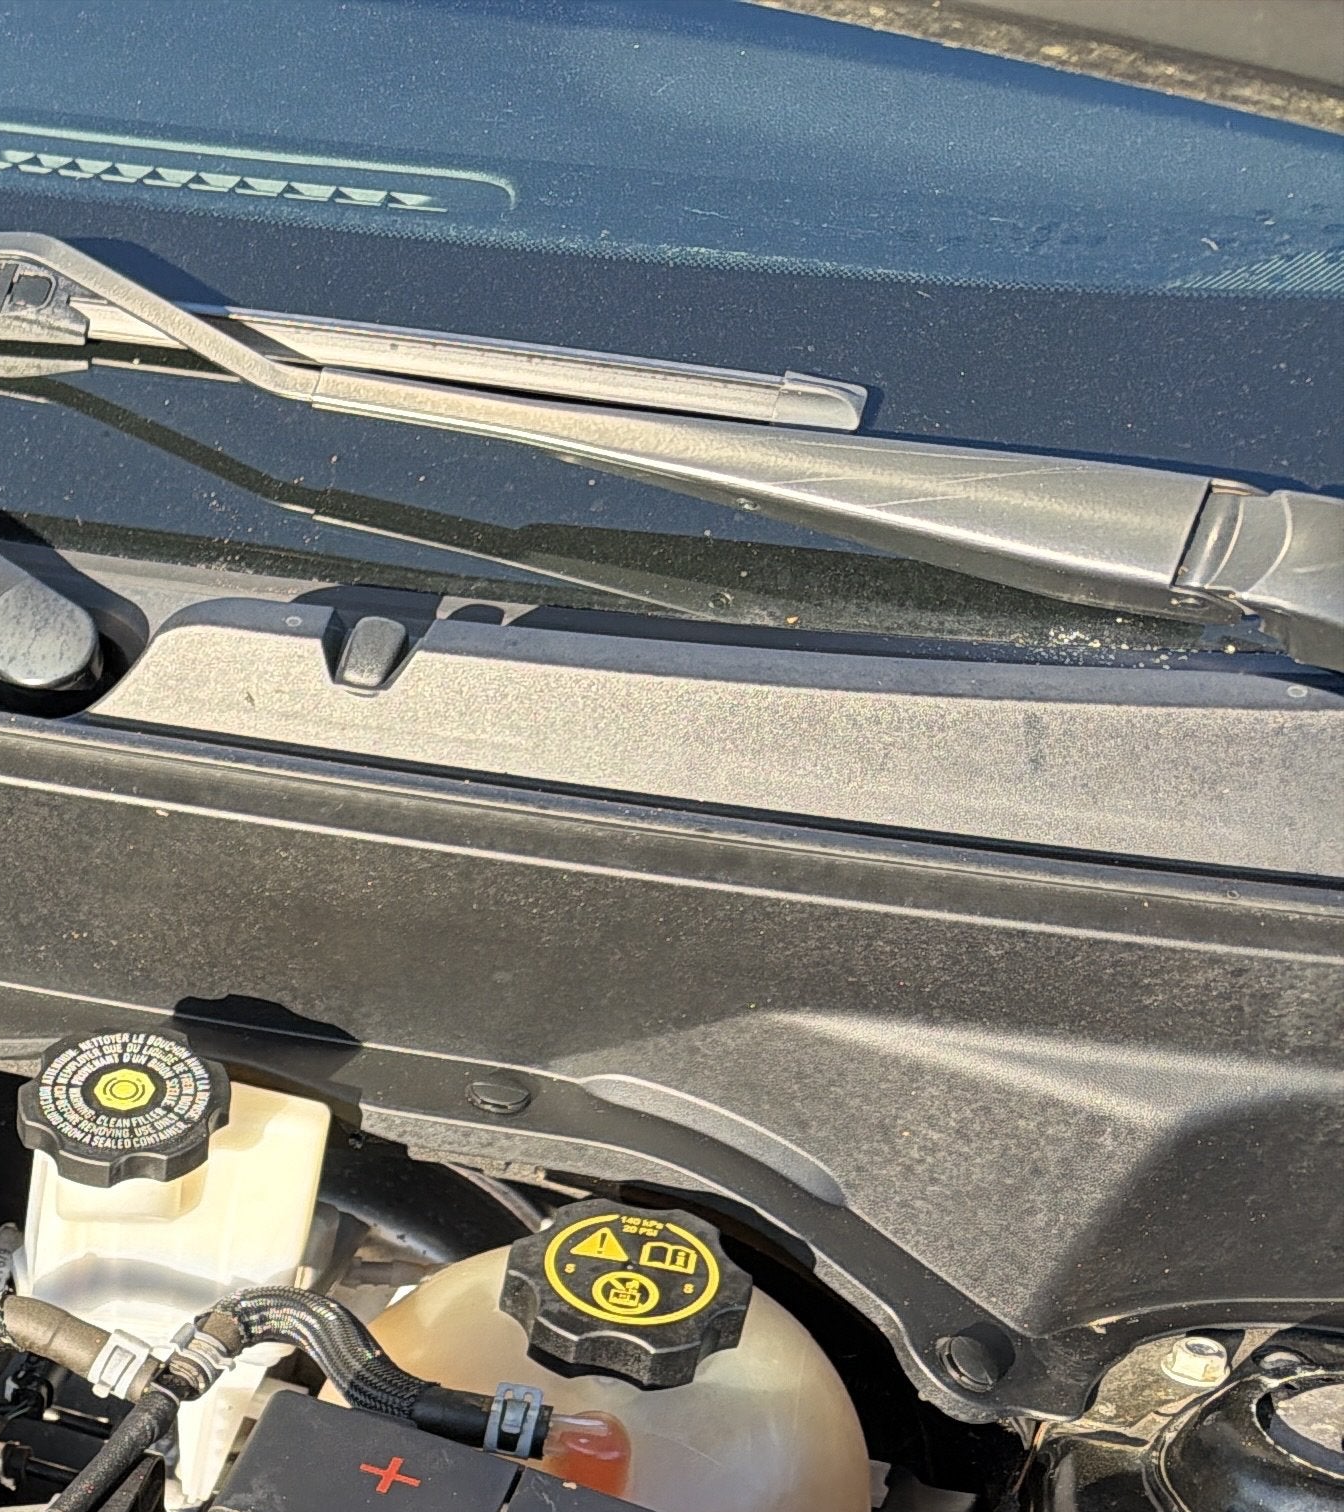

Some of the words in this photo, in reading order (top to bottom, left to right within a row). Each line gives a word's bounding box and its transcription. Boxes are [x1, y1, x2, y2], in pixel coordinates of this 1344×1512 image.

[78, 1032, 130, 1051] NETTOYER
[132, 1033, 146, 1044] LE
[146, 1034, 192, 1059] BOUCHON
[102, 1043, 123, 1054] QUE
[126, 1042, 141, 1053] DU
[56, 1099, 83, 1125] BEFORE
[78, 1120, 133, 1138] REMOVING.
[134, 1124, 156, 1137] USE
[154, 1113, 180, 1130] ONLY
[96, 1115, 130, 1127] CLEAN
[131, 1108, 168, 1127] FILLER
[57, 1121, 85, 1141] FROM
[82, 1134, 92, 1144] A
[91, 1136, 131, 1149] SEALED
